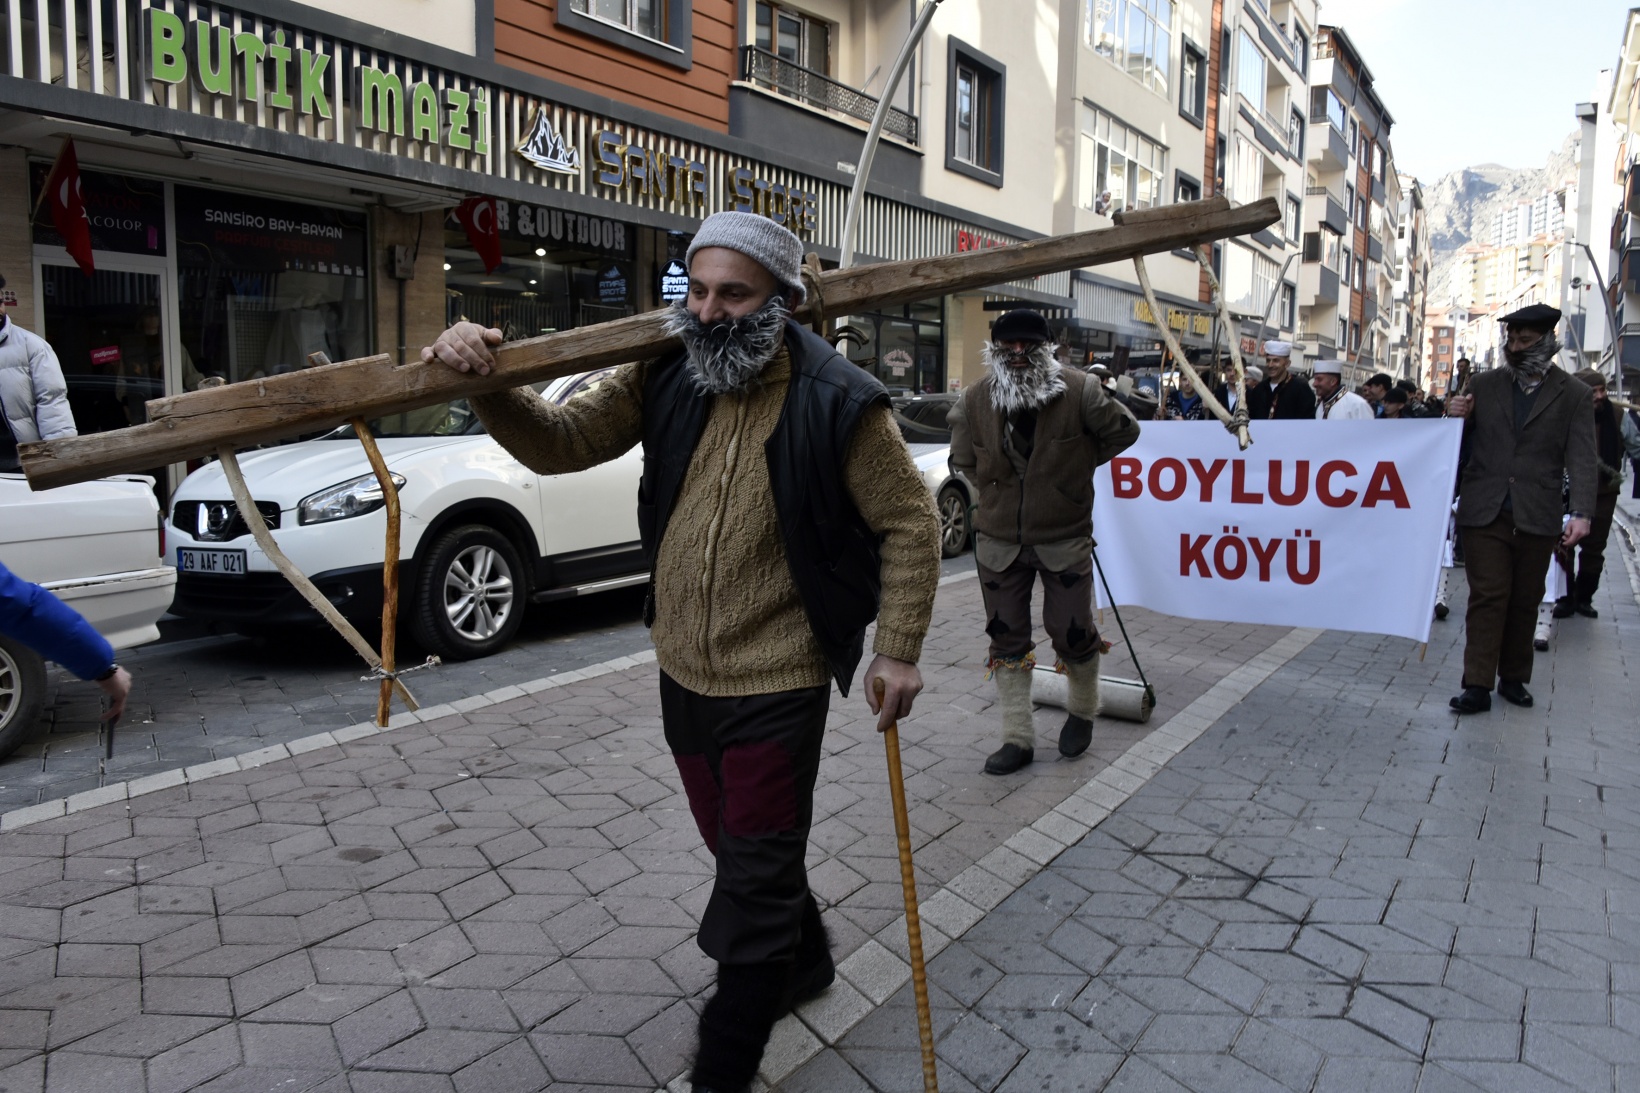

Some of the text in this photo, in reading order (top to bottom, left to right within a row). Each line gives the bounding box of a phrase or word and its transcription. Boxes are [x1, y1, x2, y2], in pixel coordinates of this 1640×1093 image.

[595, 129, 817, 231] SANTA STORE
[204, 208, 343, 240] SANSİRO BAY-BAYAN
[662, 275, 689, 285] SANTA
[662, 284, 689, 293] STORE
[1110, 456, 1411, 509] BOYLUCA
[183, 552, 241, 571] 29 AAF 021
[1179, 525, 1321, 585] KÖYÜ
